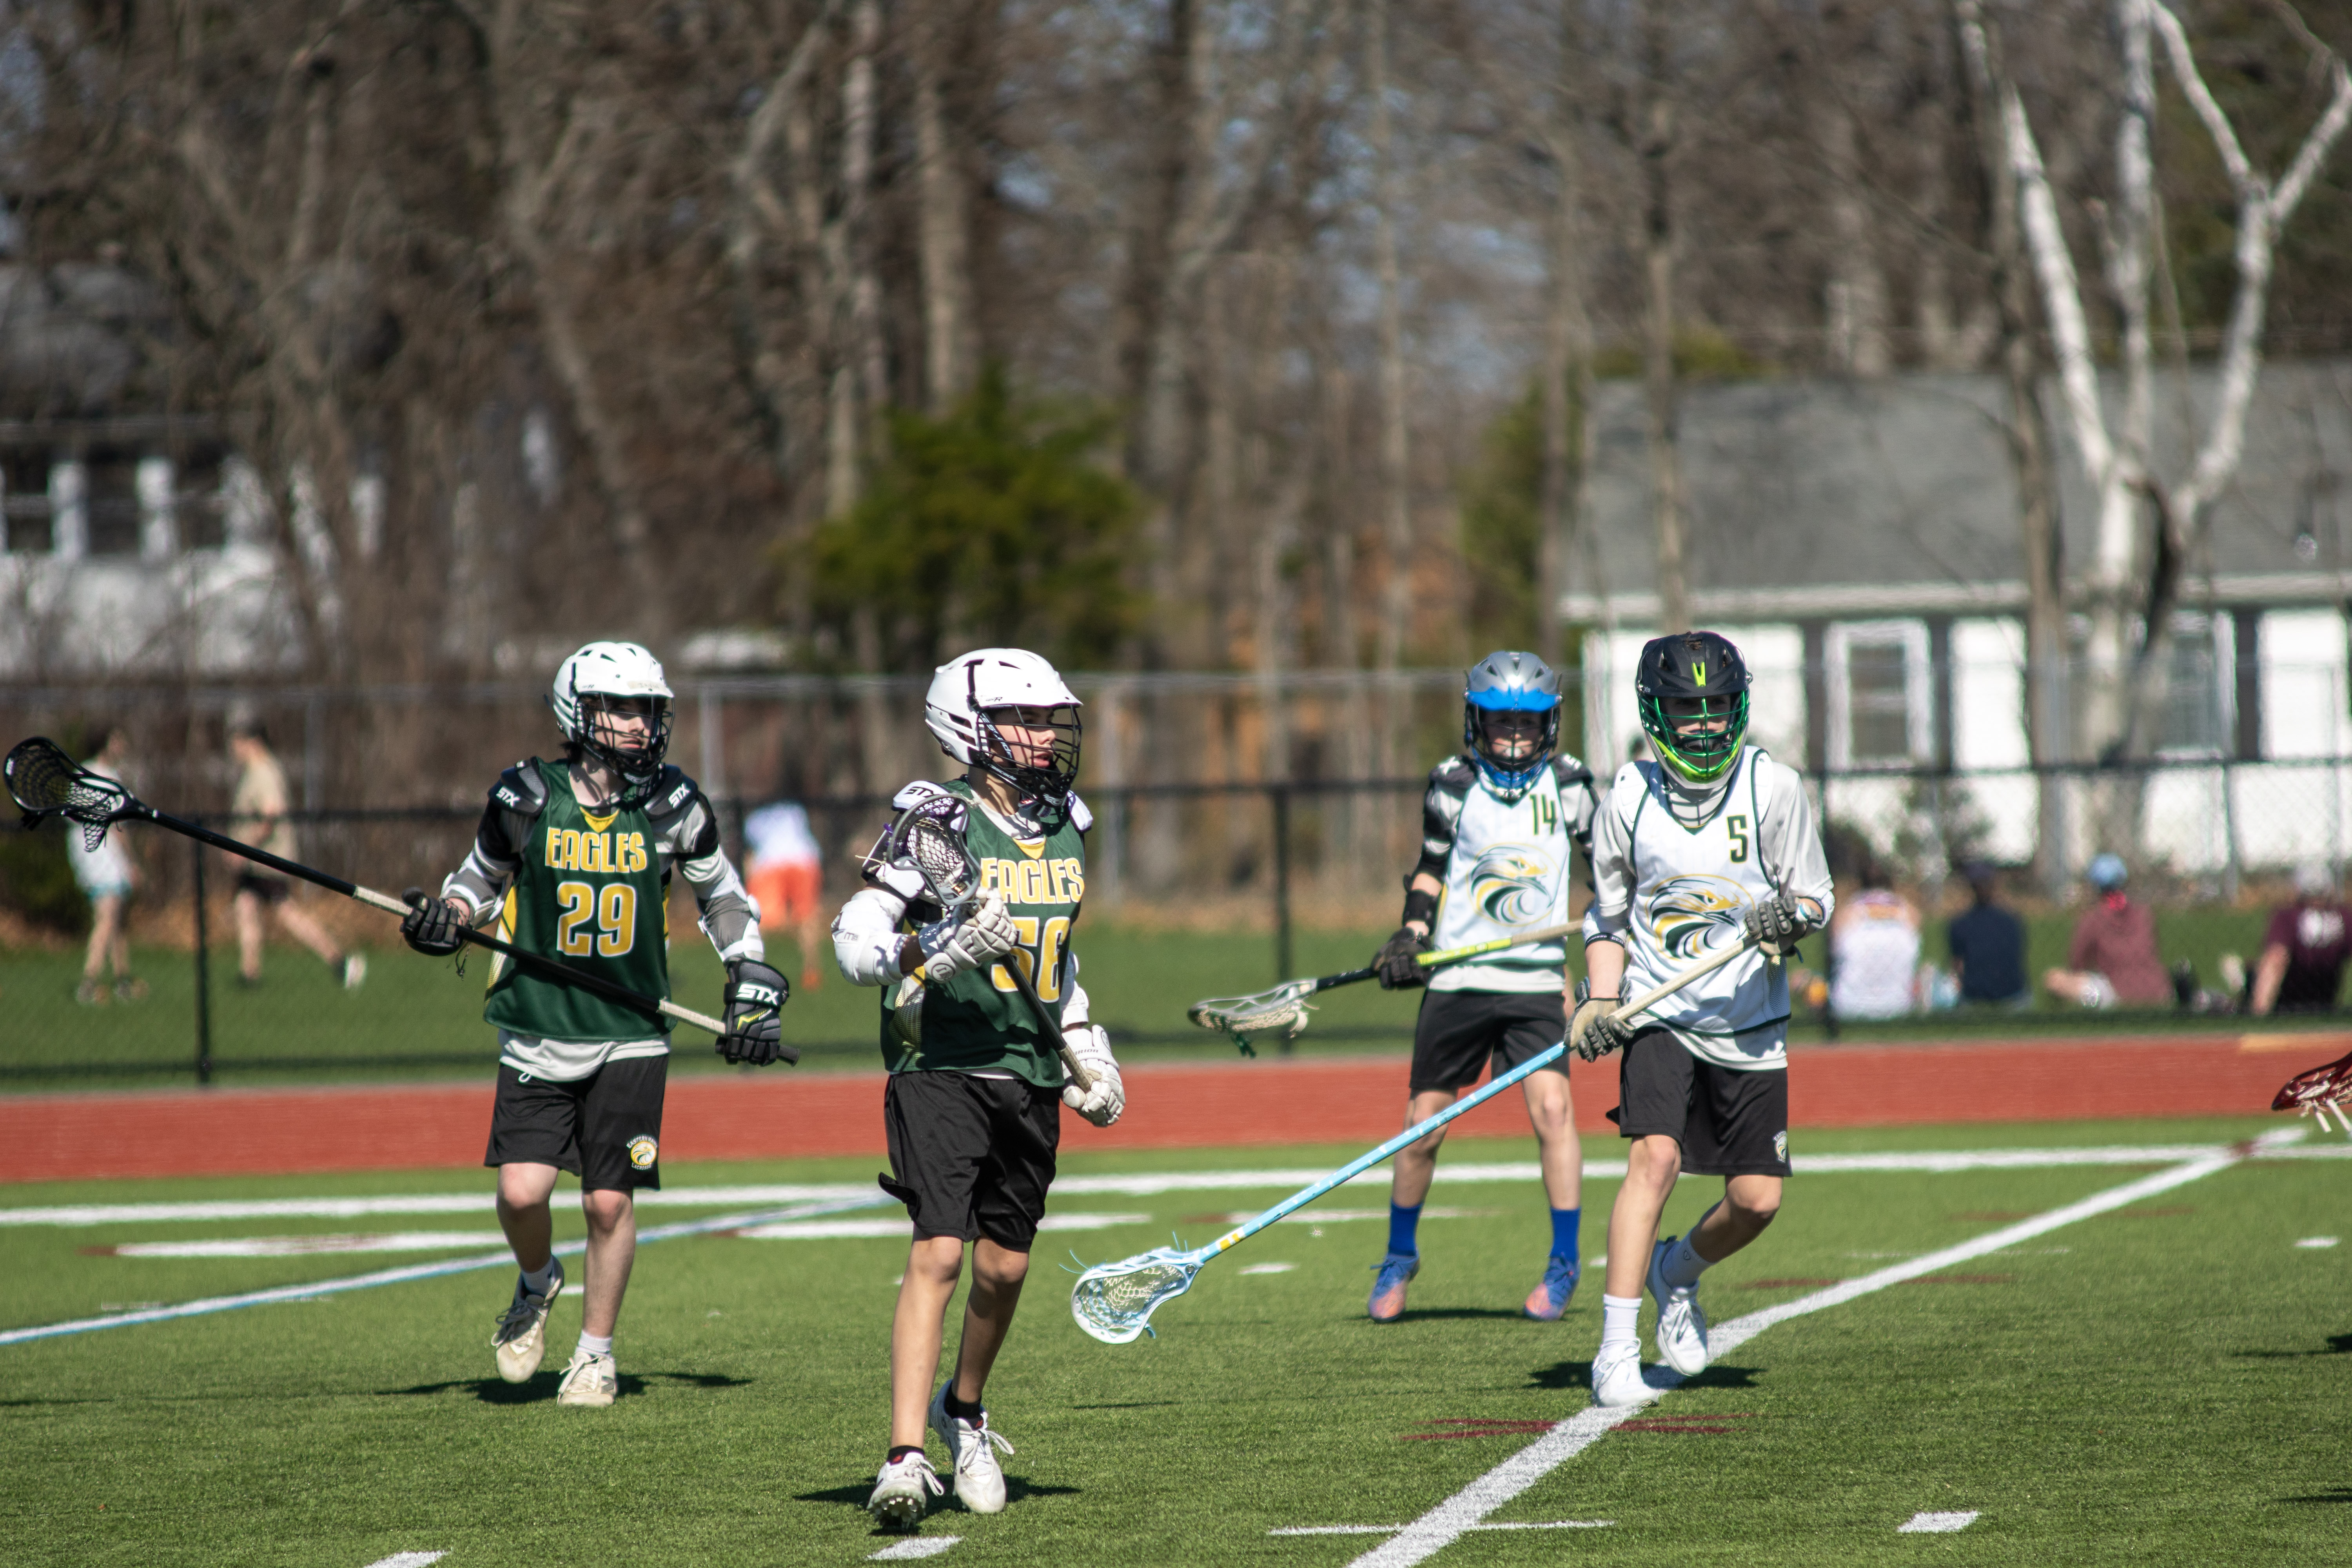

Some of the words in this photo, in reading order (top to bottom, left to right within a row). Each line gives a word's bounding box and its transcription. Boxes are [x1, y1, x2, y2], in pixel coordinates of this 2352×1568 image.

[496, 786, 520, 808] STX
[668, 782, 690, 809] STX
[1530, 794, 1557, 836] 14
[544, 826, 647, 873] EAGLES
[1727, 815, 1748, 864] 5
[980, 857, 1085, 904] EAGLES
[557, 881, 636, 957] 29
[735, 984, 779, 1006] STX
